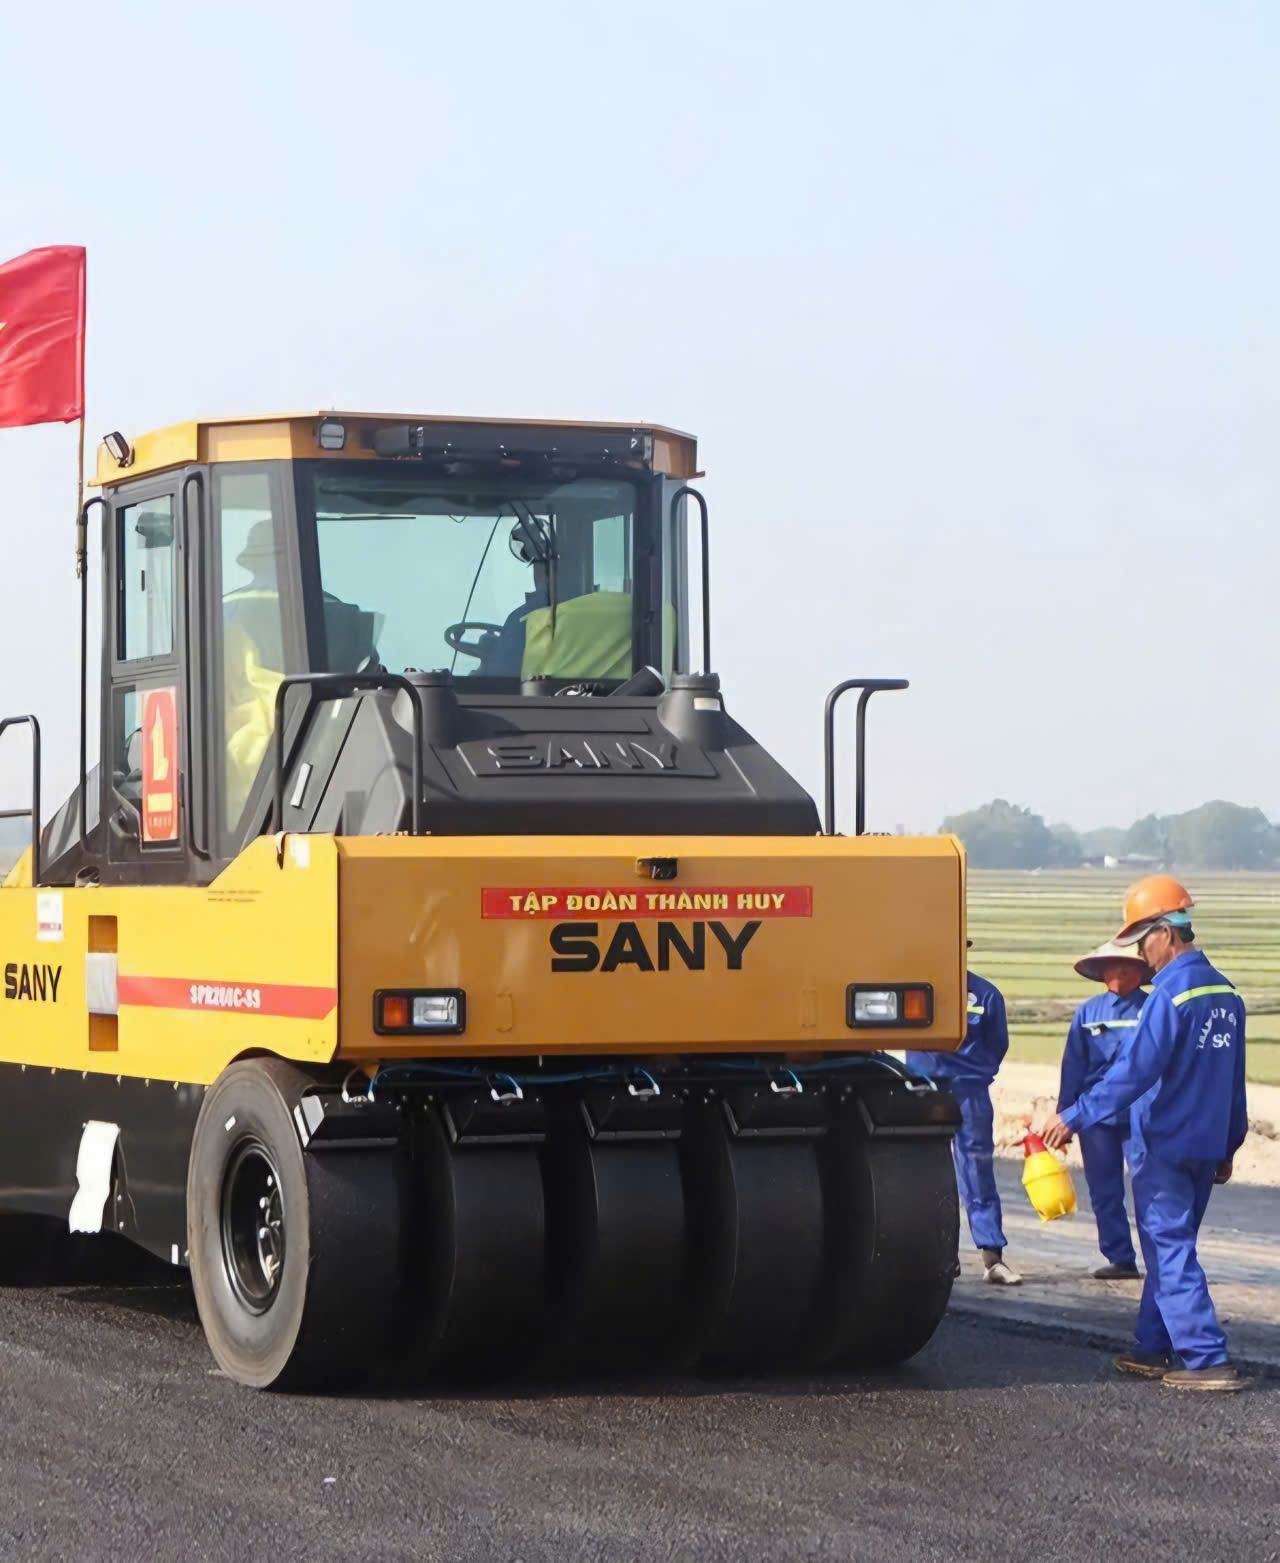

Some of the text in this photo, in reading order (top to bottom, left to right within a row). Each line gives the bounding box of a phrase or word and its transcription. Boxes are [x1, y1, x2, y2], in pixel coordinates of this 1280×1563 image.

[487, 739, 680, 770] SANY
[508, 891, 558, 915] TẬP
[737, 893, 785, 910] HUY
[549, 921, 762, 972] SANY
[4, 963, 63, 1003] SANY
